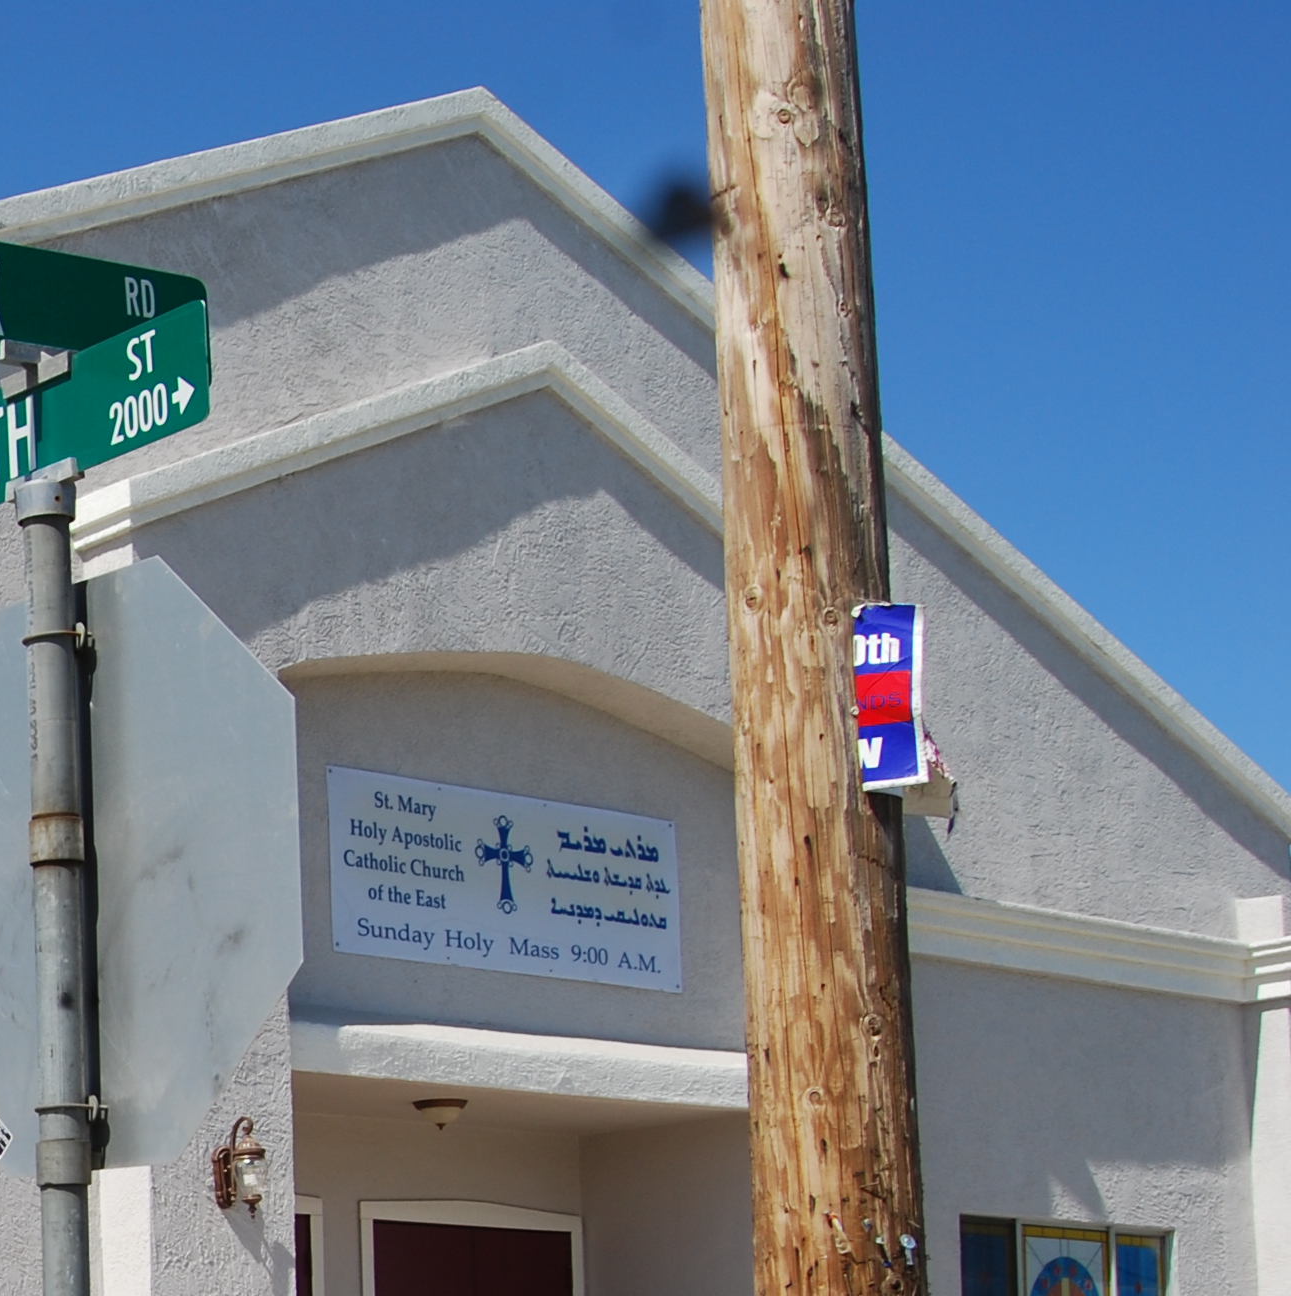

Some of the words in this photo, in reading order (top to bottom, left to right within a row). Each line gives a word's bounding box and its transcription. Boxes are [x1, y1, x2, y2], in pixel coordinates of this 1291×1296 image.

[124, 276, 156, 319] RD
[126, 329, 156, 382] ST
[109, 382, 169, 446] 2000
[373, 790, 395, 812] St.
[397, 794, 437, 822] Mary
[349, 818, 387, 844] Holy
[391, 826, 462, 853] Apostolic
[343, 849, 407, 875] Catholic
[410, 859, 465, 884] Church
[367, 885, 386, 902] of
[387, 886, 413, 904] the
[415, 889, 447, 910] East
[357, 918, 435, 947] Sunday
[444, 929, 494, 957] Holy
[509, 936, 560, 961] Mass
[570, 945, 609, 967] 9:00
[617, 951, 662, 974] A.M.
